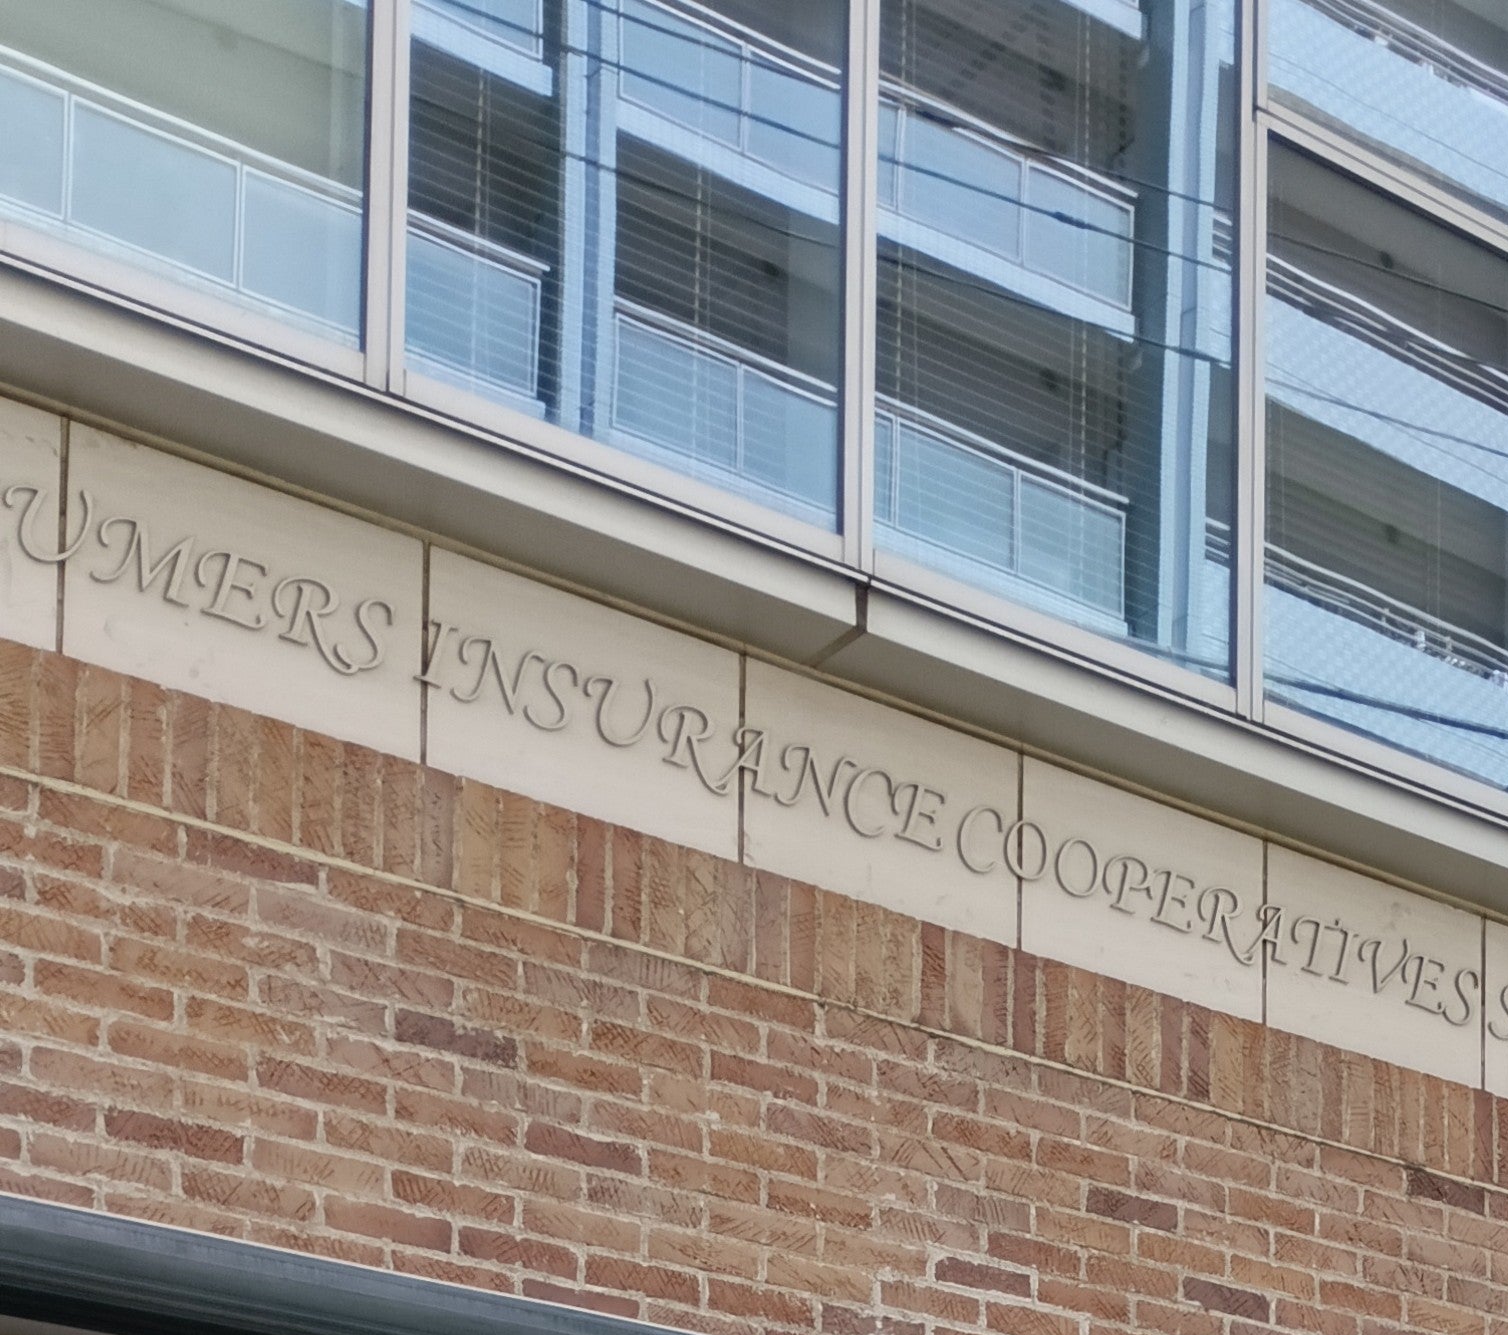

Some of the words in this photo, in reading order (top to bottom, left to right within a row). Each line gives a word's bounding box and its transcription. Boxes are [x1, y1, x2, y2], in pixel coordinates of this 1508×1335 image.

[2, 484, 395, 676] UMERS
[413, 618, 945, 851] INSURANCE
[956, 805, 1481, 1027] COOPERATIVES
